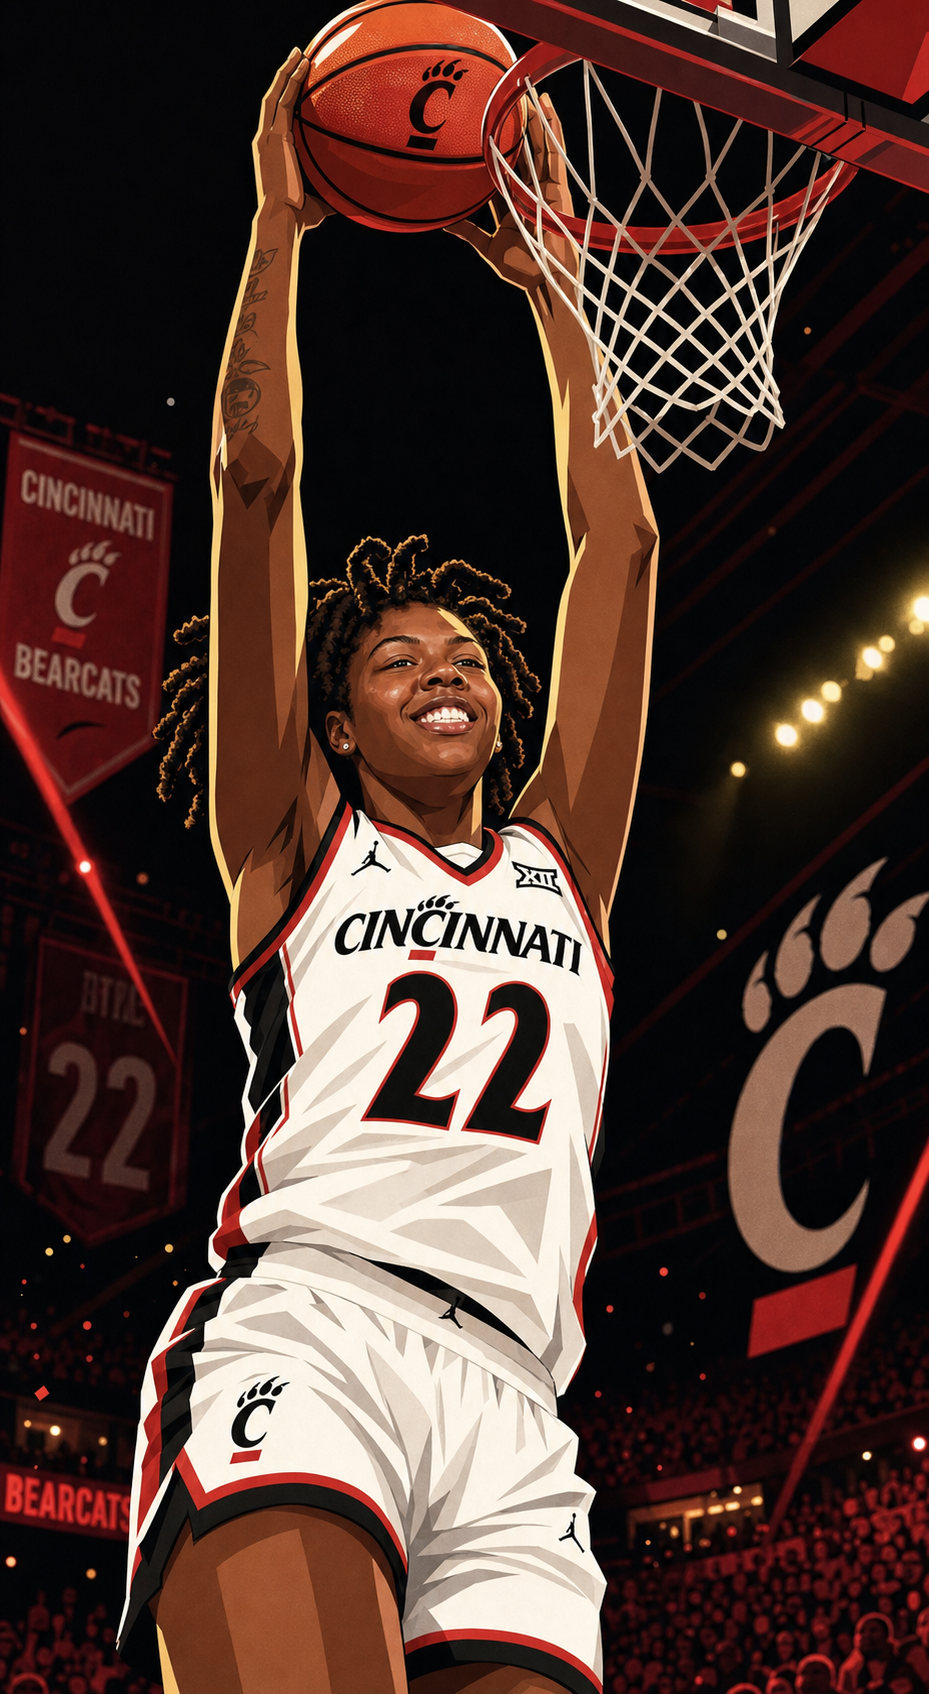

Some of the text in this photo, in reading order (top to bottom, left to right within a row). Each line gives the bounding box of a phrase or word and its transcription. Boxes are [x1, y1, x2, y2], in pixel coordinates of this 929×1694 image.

[20, 469, 155, 542] CINCINNATI
[14, 642, 141, 710] BEARCATS
[334, 908, 583, 976] CINCINNATI
[360, 970, 552, 1145] 22
[44, 1041, 157, 1193] 22
